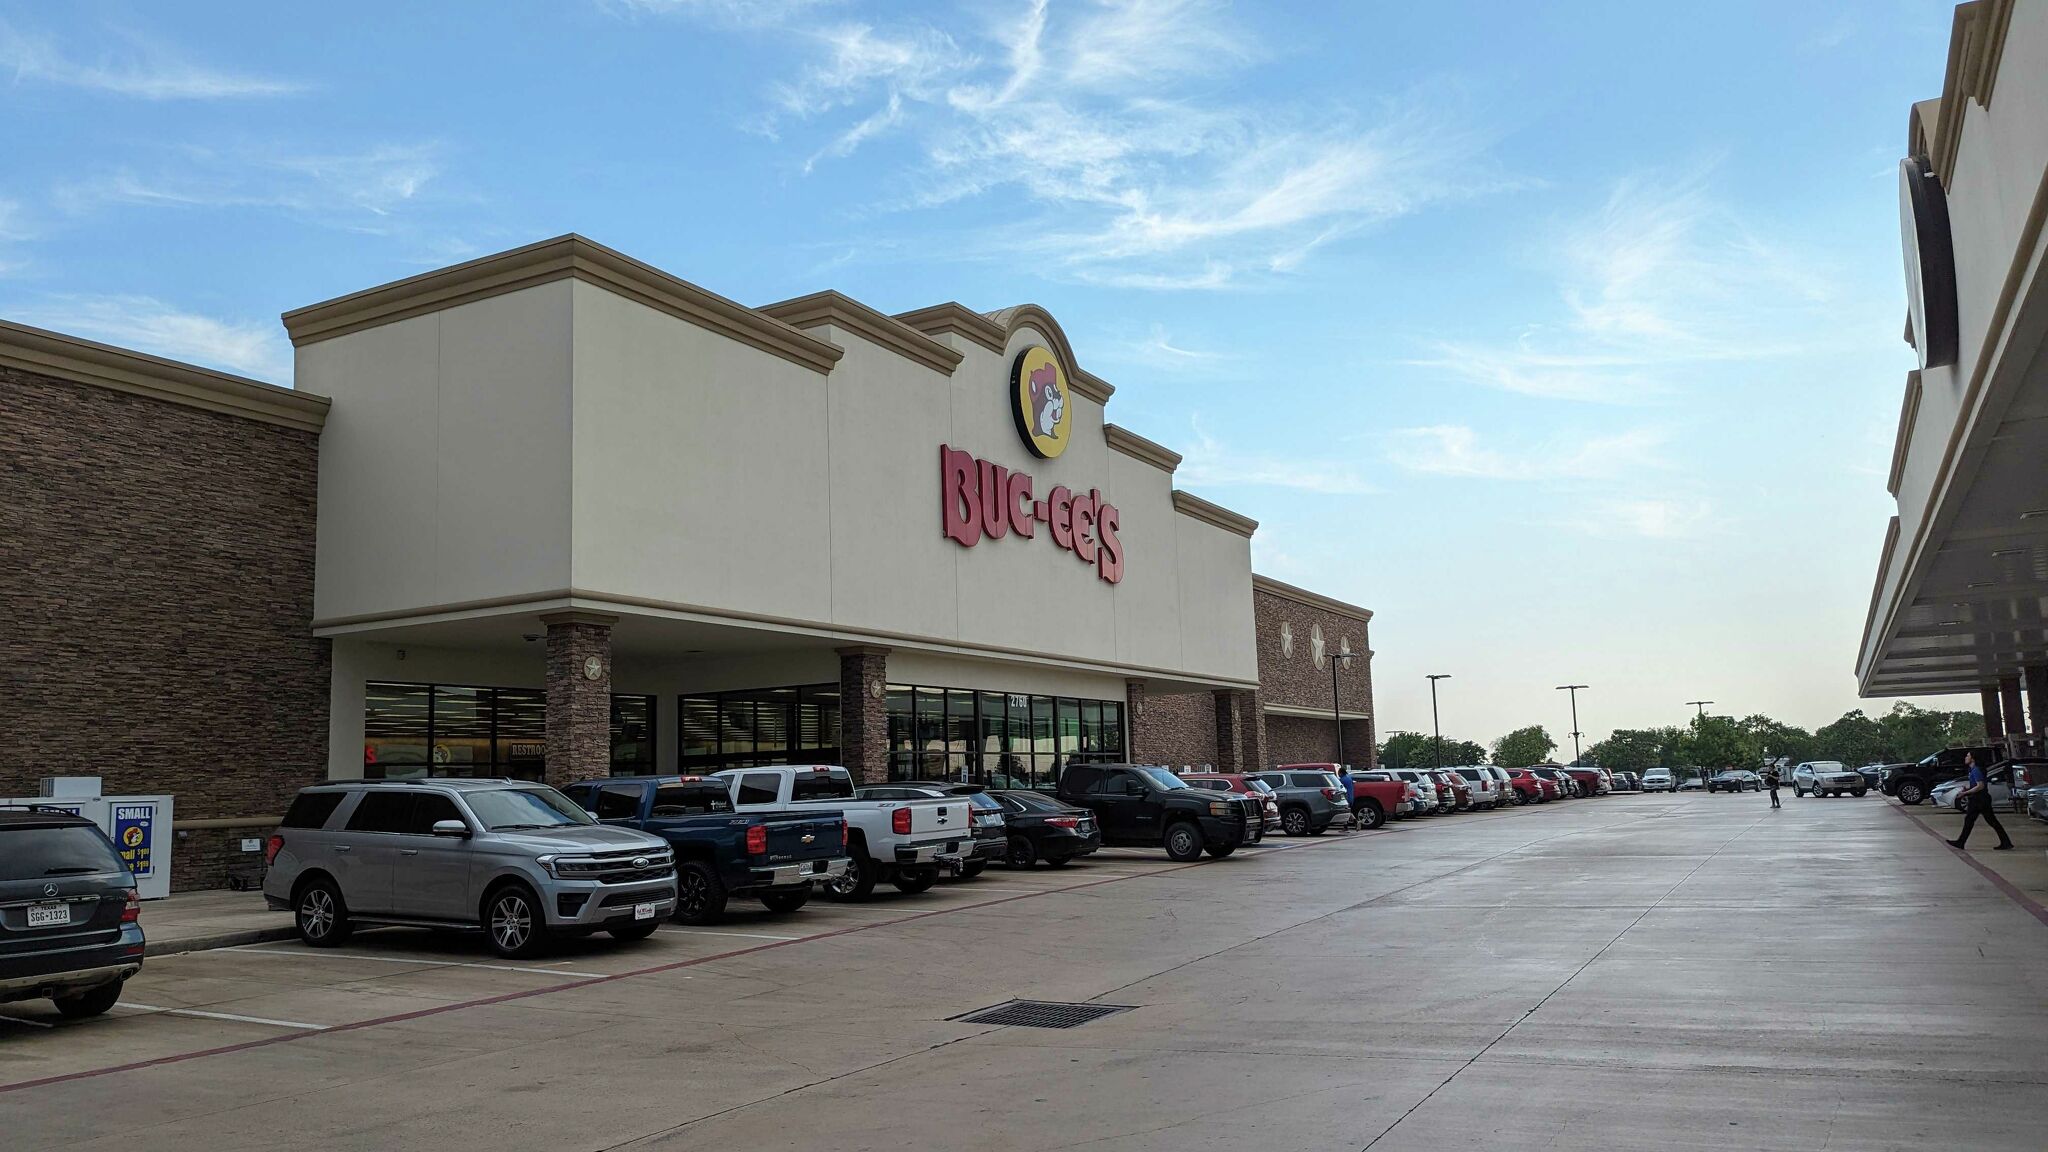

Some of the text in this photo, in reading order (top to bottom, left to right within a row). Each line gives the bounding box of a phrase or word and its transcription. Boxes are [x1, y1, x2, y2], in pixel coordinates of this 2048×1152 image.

[512, 744, 545, 756] RESTROO
[118, 808, 150, 820] SMALL
[120, 849, 135, 860] mall
